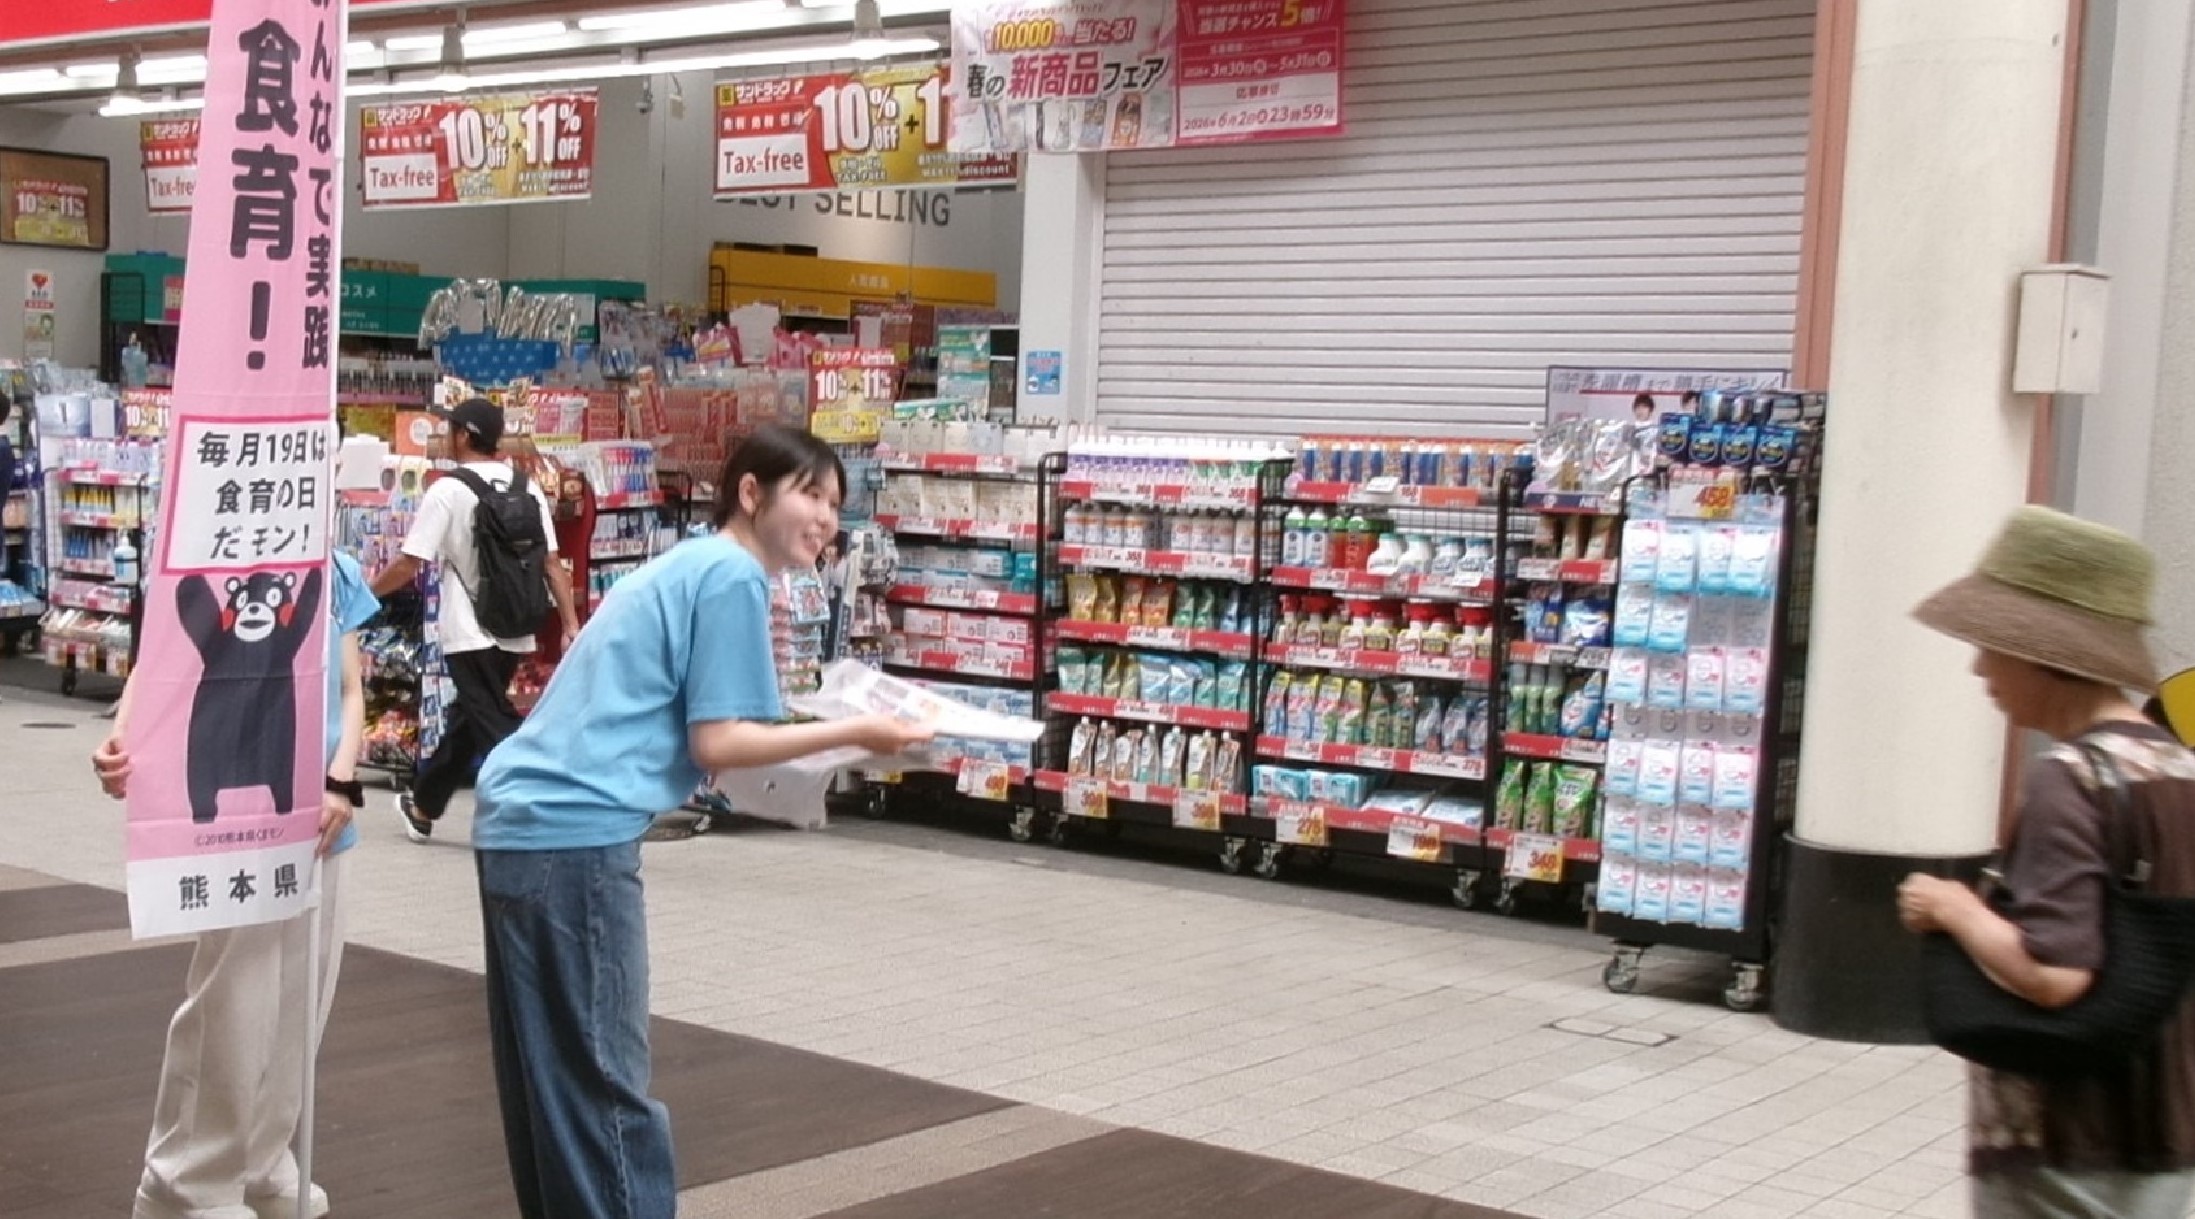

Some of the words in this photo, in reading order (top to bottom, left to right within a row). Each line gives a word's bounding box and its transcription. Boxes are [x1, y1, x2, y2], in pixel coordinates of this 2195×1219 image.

[967, 51, 1166, 99] 春の新商品フェア
[370, 165, 435, 188] Tax-free
[724, 148, 805, 175] Tax-free
[151, 177, 195, 196] Tax-fre
[231, 19, 301, 369] 食育!
[303, 0, 333, 369] んなで実践
[815, 190, 950, 226] SELLING
[197, 430, 326, 468] 毎月19日は
[215, 476, 316, 516] 食育の日
[210, 525, 310, 561] だモン!
[179, 862, 299, 910] 熊本県
